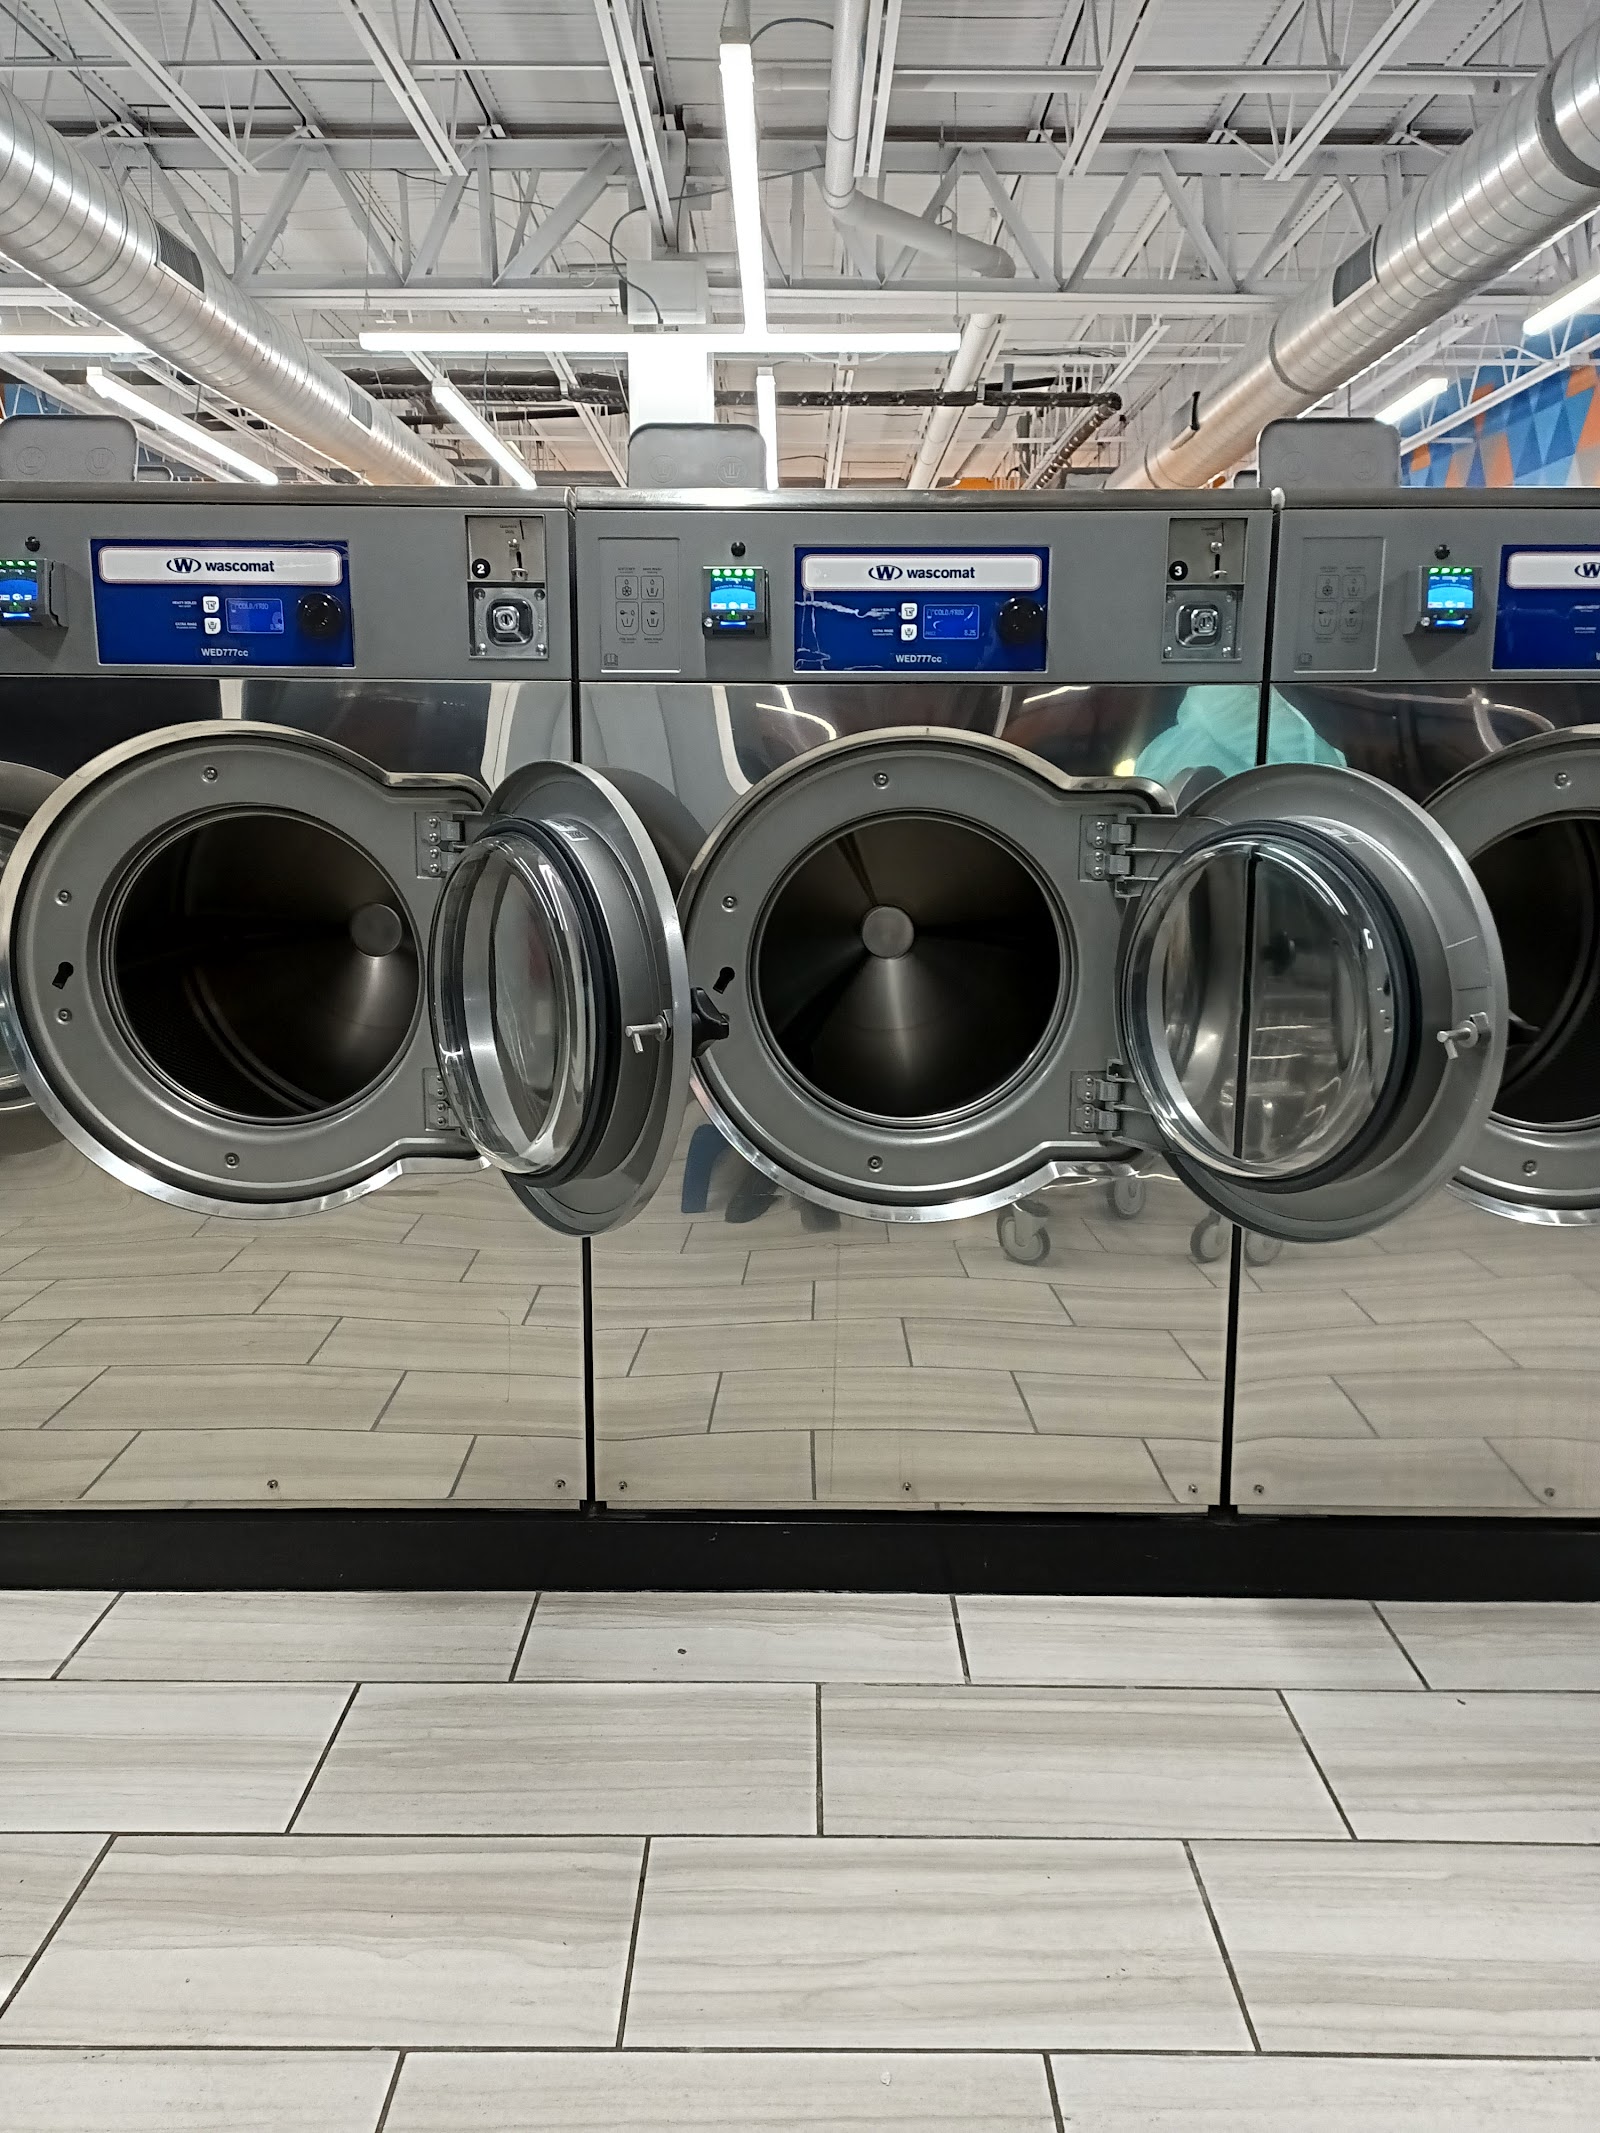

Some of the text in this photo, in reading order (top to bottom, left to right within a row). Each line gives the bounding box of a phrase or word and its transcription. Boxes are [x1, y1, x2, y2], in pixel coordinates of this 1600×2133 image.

[204, 560, 275, 572] wascomat
[476, 563, 485, 574] 2
[1174, 566, 1183, 576] 3
[906, 567, 975, 579] wascomat
[201, 648, 249, 657] WED777cc
[895, 655, 942, 663] WED777cc
